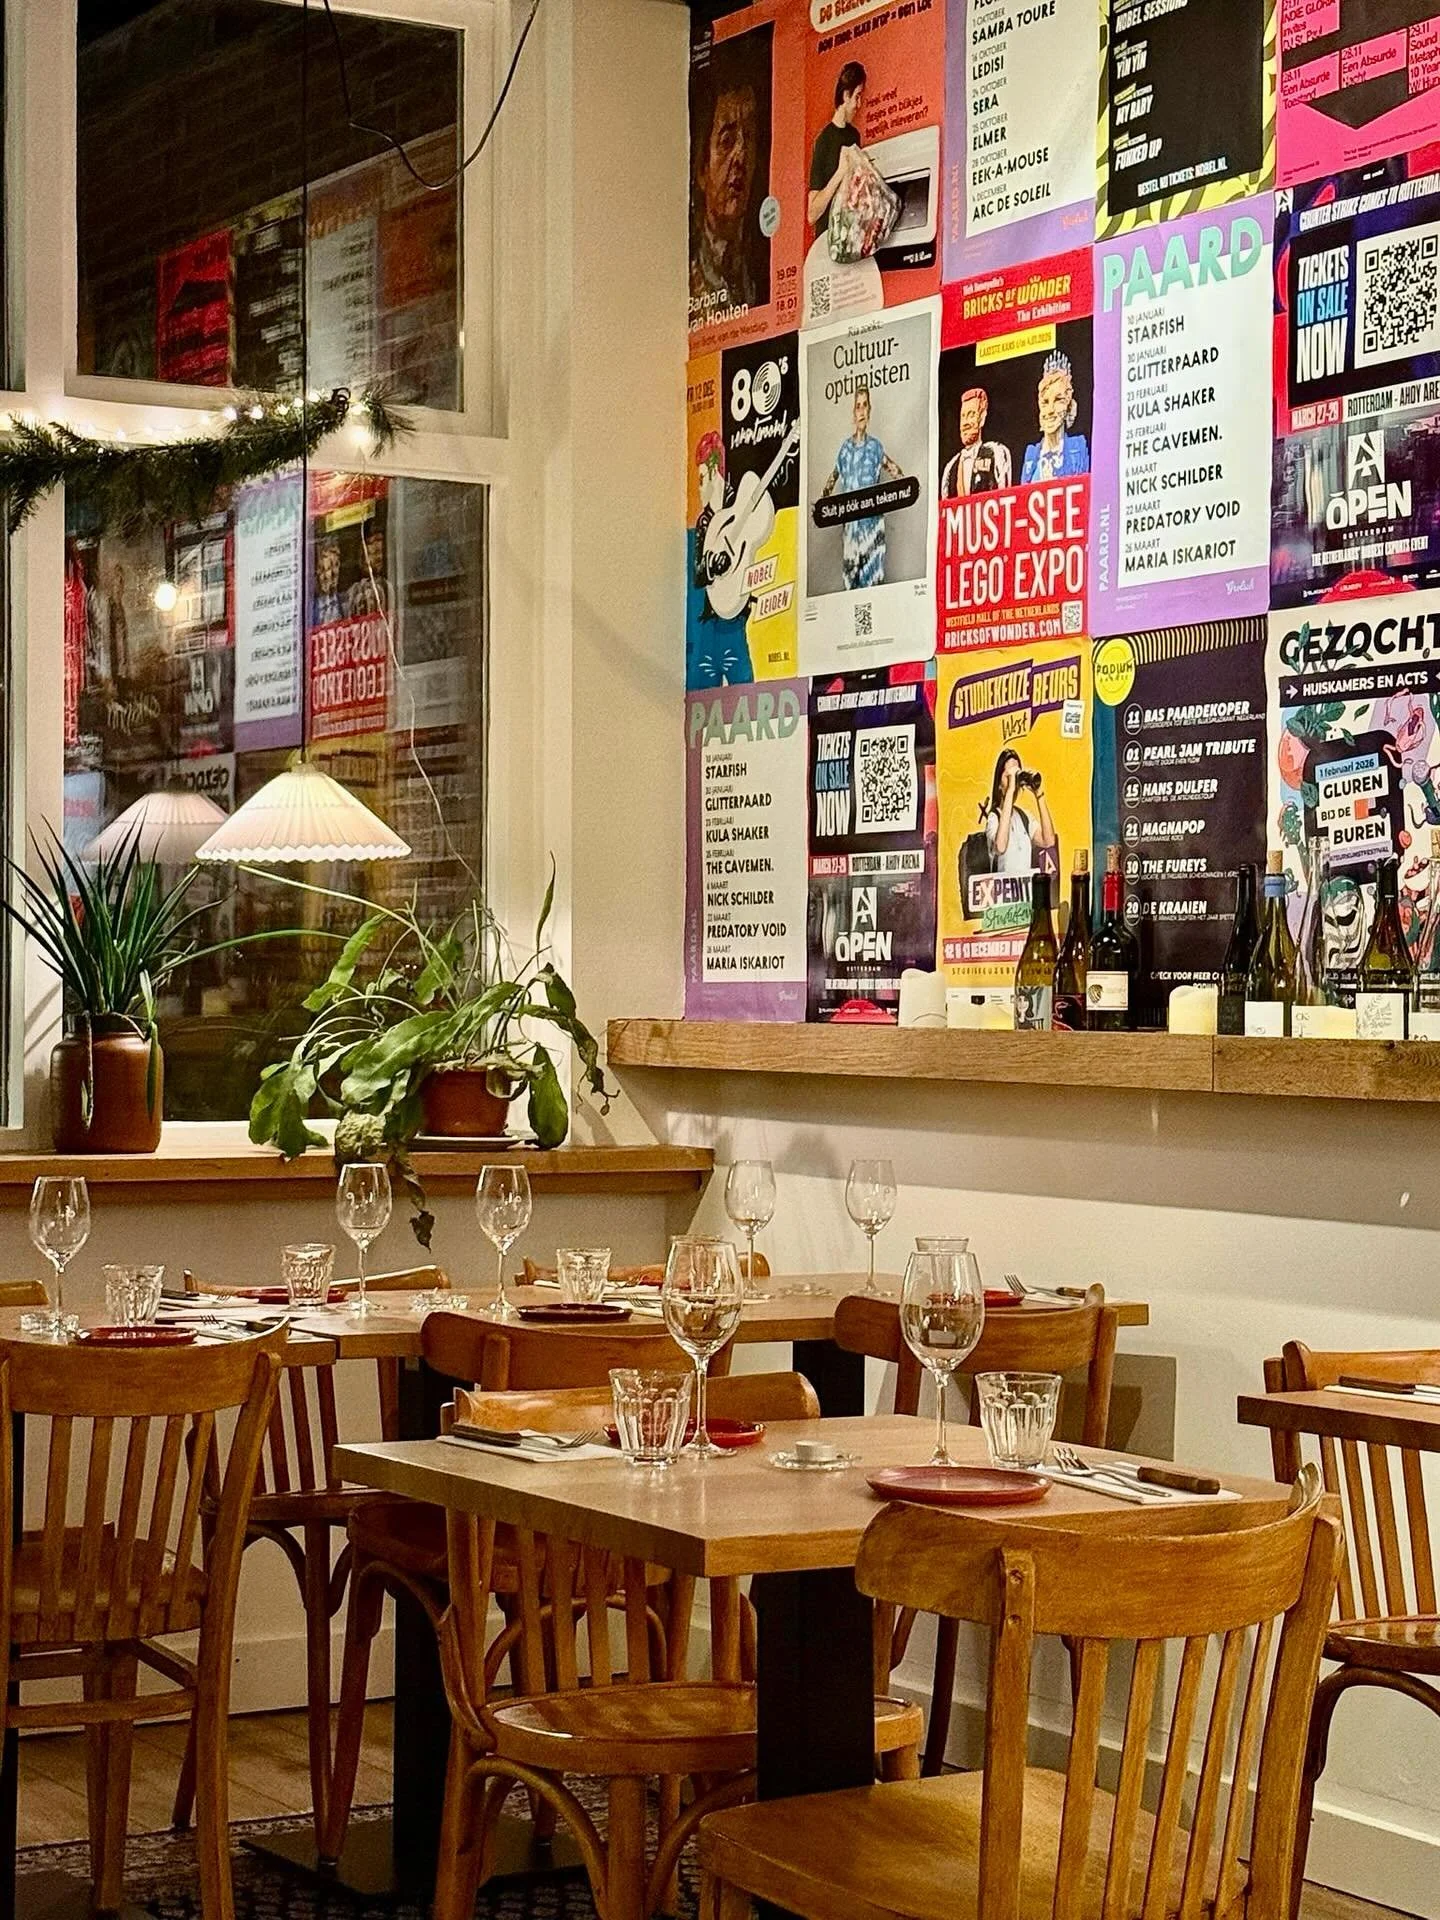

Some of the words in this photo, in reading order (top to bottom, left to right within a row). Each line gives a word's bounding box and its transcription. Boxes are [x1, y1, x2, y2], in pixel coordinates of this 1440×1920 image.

[972, 17, 1014, 45] SAMBA
[1017, 0, 1056, 28] TOURE
[977, 7, 1006, 26] OKTOBER
[979, 41, 1007, 60] OKTOBER
[1410, 32, 1438, 51] Sound
[972, 55, 1004, 81] LEDISI
[1343, 61, 1359, 74] Een
[1360, 48, 1397, 69] Absurde
[1410, 66, 1420, 79] 10
[980, 76, 1007, 95] OKTOBER
[1299, 71, 1330, 89] Absurde
[973, 93, 999, 116] SERA
[979, 112, 1008, 132] OKTOBER
[973, 127, 1007, 151] ELMER
[1149, 138, 1163, 159] UP
[981, 148, 1007, 166] OKTOBER
[973, 201, 994, 222] ARC
[997, 195, 1010, 213] DE
[1013, 182, 1051, 207] SOLEIL
[977, 183, 1007, 202] DECEMBER
[1103, 216, 1263, 313] PAARD
[1298, 245, 1349, 291] TICKETS
[963, 292, 1004, 320] BRICKS
[1017, 274, 1072, 306] WONDER
[1297, 292, 1315, 326] ON
[1317, 281, 1349, 322] SALE
[706, 303, 749, 326] Houten
[1017, 309, 1031, 323] The
[1135, 306, 1165, 323] JANUARI
[1127, 315, 1185, 345] STARFISH
[833, 336, 900, 369] Cultuur-
[1136, 346, 1167, 363] JANUARI
[1296, 316, 1348, 383] NOW
[1127, 346, 1219, 383] GLITTERPAARD
[825, 362, 910, 404] optimisten
[1136, 383, 1168, 399] FEBRUARI
[1127, 399, 1160, 422] KULA
[1164, 386, 1216, 413] SHAKER
[1347, 390, 1393, 418] ROTTERDAM
[1400, 384, 1422, 406] AHOY
[1135, 422, 1167, 437] FEBRUARI
[1291, 406, 1316, 431] MARCH
[1126, 440, 1149, 459] THE
[1152, 424, 1223, 454] CAVEMEN.
[1126, 476, 1157, 497] NICK
[1161, 464, 1223, 490] SCHILDER
[1132, 462, 1158, 477] MAART
[821, 504, 837, 518] Sluit
[837, 503, 846, 517] je
[876, 492, 898, 507] teken
[898, 486, 912, 501] nu!
[1135, 499, 1161, 514] MAART
[1126, 506, 1201, 535] PREDATORY
[1205, 500, 1241, 521] VOID
[1342, 525, 1394, 540] ROTTERDAM
[1098, 504, 1111, 592] PAARD.NL
[1125, 552, 1169, 573] MARIA
[1172, 540, 1236, 565] ISKARIOT
[1134, 538, 1161, 552] MAART
[747, 564, 773, 588] NOBEL
[759, 591, 789, 616] LEIDEN
[944, 618, 1061, 648] BRICKSOFWONDER.COM
[1280, 612, 1440, 666] GEZOCHT
[954, 667, 1032, 720] STUDIEKEUZE
[1032, 664, 1078, 707] BEURS
[1303, 677, 1374, 697] HUISKAMERS
[1377, 675, 1393, 688] EN
[1396, 671, 1428, 686] ACTS
[689, 689, 800, 749] PAARD
[1127, 710, 1140, 725] 11
[1144, 709, 1166, 723] BAS
[1167, 700, 1250, 721] PAARDEKOPER
[816, 731, 851, 761] TICKETS
[1126, 748, 1140, 761] 01
[1144, 744, 1177, 760] PEARL
[1179, 743, 1203, 757] JAM
[1205, 739, 1257, 756] TRIBUTE
[705, 763, 747, 780] STARFISH
[815, 762, 828, 790] ON
[828, 761, 849, 789] SALE
[1324, 762, 1354, 777] februari
[1355, 758, 1375, 770] 2026
[1126, 784, 1139, 797] 15
[1142, 782, 1174, 797] HANS
[1174, 779, 1219, 795] DULFER
[1323, 774, 1383, 799] GLUREN
[705, 793, 772, 811] GLITTERPAARD
[816, 789, 850, 837] NOW
[1321, 810, 1336, 821] BIJ
[1338, 807, 1351, 818] DE
[706, 828, 730, 843] KULA
[731, 825, 769, 842] SHAKER
[1126, 823, 1138, 836] 21
[1142, 820, 1206, 836] MAGNAPOP
[1333, 821, 1386, 844] BUREN
[706, 861, 723, 875] THE
[724, 858, 774, 874] CAVEMEN.
[886, 855, 900, 871] AHOY
[901, 853, 920, 870] ARENA
[1126, 860, 1139, 874] 30
[1142, 860, 1164, 873] THE
[1165, 858, 1207, 873] FUREYS
[706, 893, 729, 906] NICK
[731, 890, 774, 906] SCHILDER
[1126, 901, 1139, 914] 20
[1142, 901, 1157, 914] DE
[1158, 901, 1208, 914] KRAAIEN
[706, 924, 759, 939] PREDATORY
[761, 923, 787, 937] VOID
[706, 956, 737, 970] MARIA
[739, 955, 785, 970] ISKARIOT
[1173, 971, 1192, 980] VOOR
[1193, 971, 1210, 980] MEER
